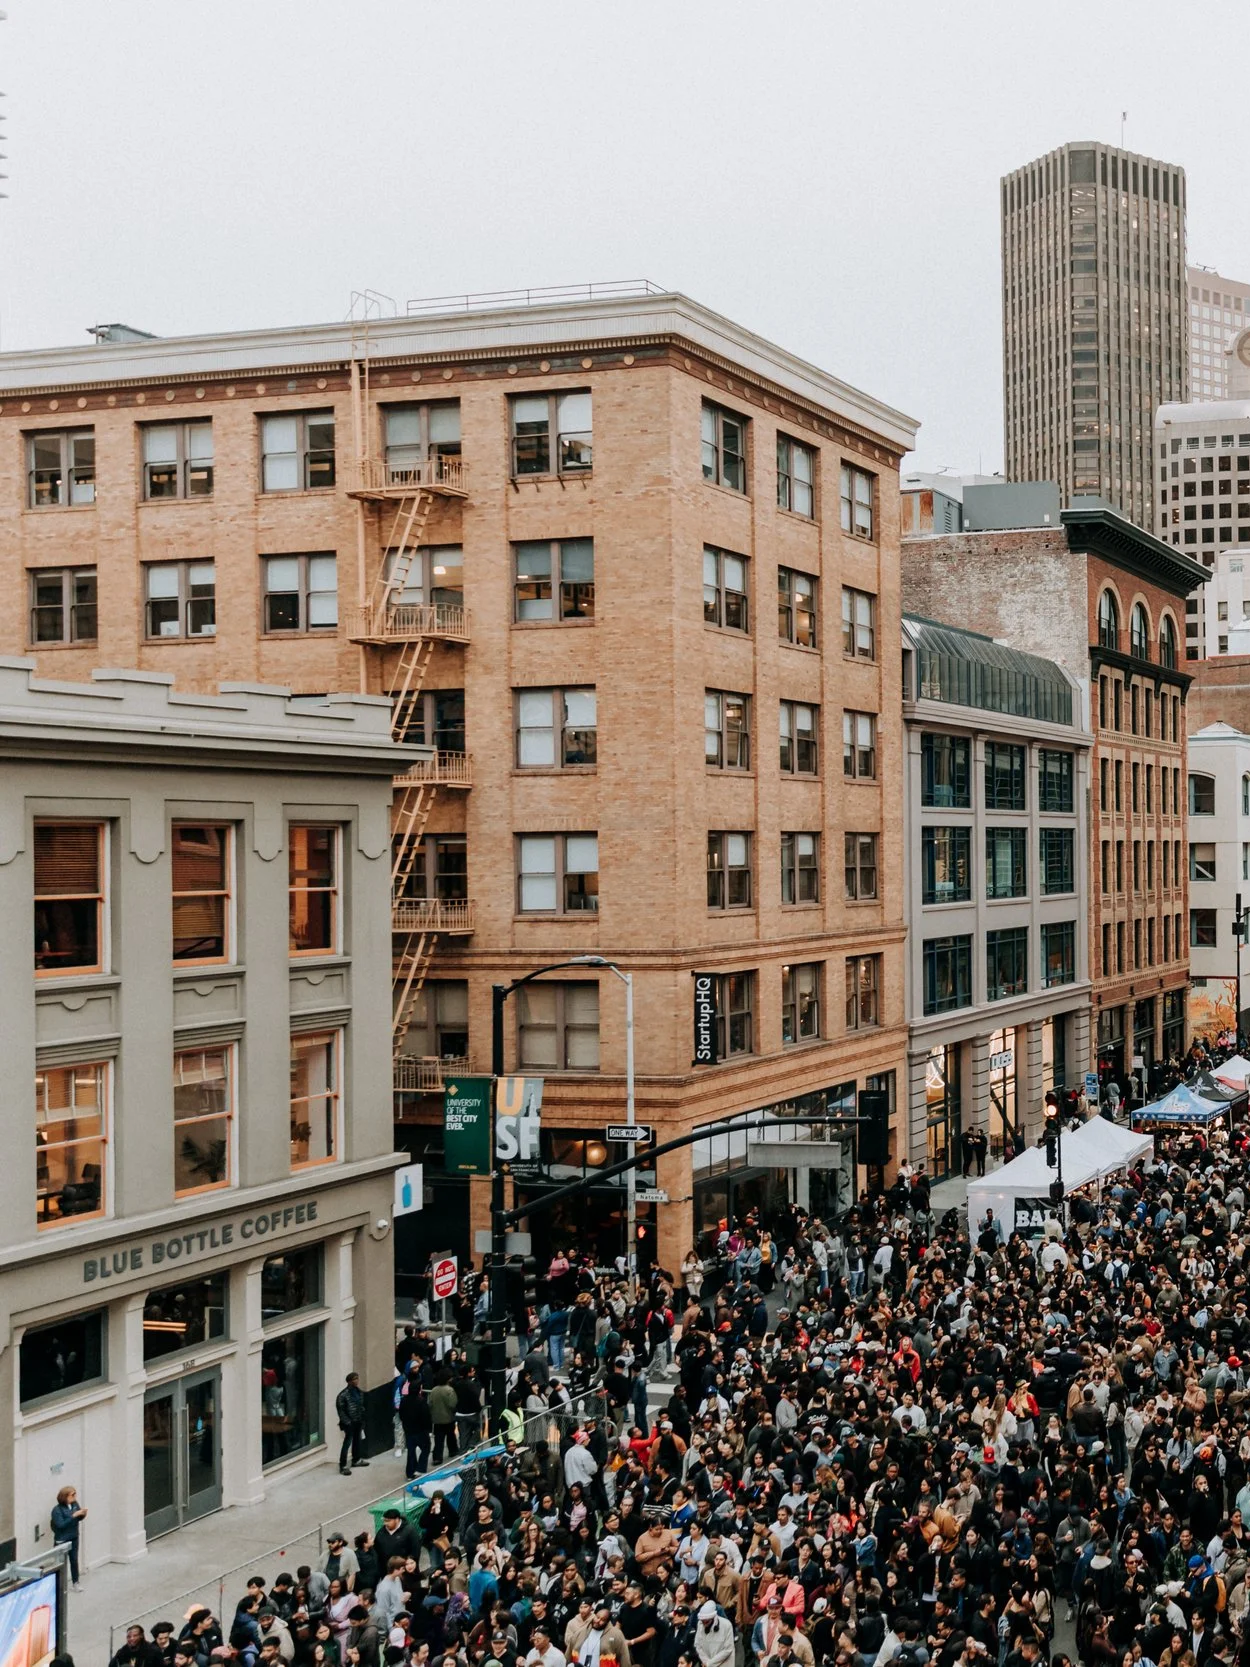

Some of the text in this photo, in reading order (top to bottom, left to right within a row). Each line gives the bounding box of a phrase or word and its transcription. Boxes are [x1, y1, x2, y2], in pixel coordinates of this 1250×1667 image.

[696, 977, 715, 1060] StartupHQ
[446, 1098, 482, 1107] UNIVERSITY
[446, 1106, 468, 1115] OF THE
[446, 1114, 478, 1123] BEST CITY
[445, 1122, 465, 1131] EVER.
[610, 1129, 639, 1137] ONE WAY
[83, 1201, 318, 1283] BLUE BOTTLE COFFEE
[437, 1264, 454, 1277] DO NOT
[438, 1281, 453, 1292] ENTER
